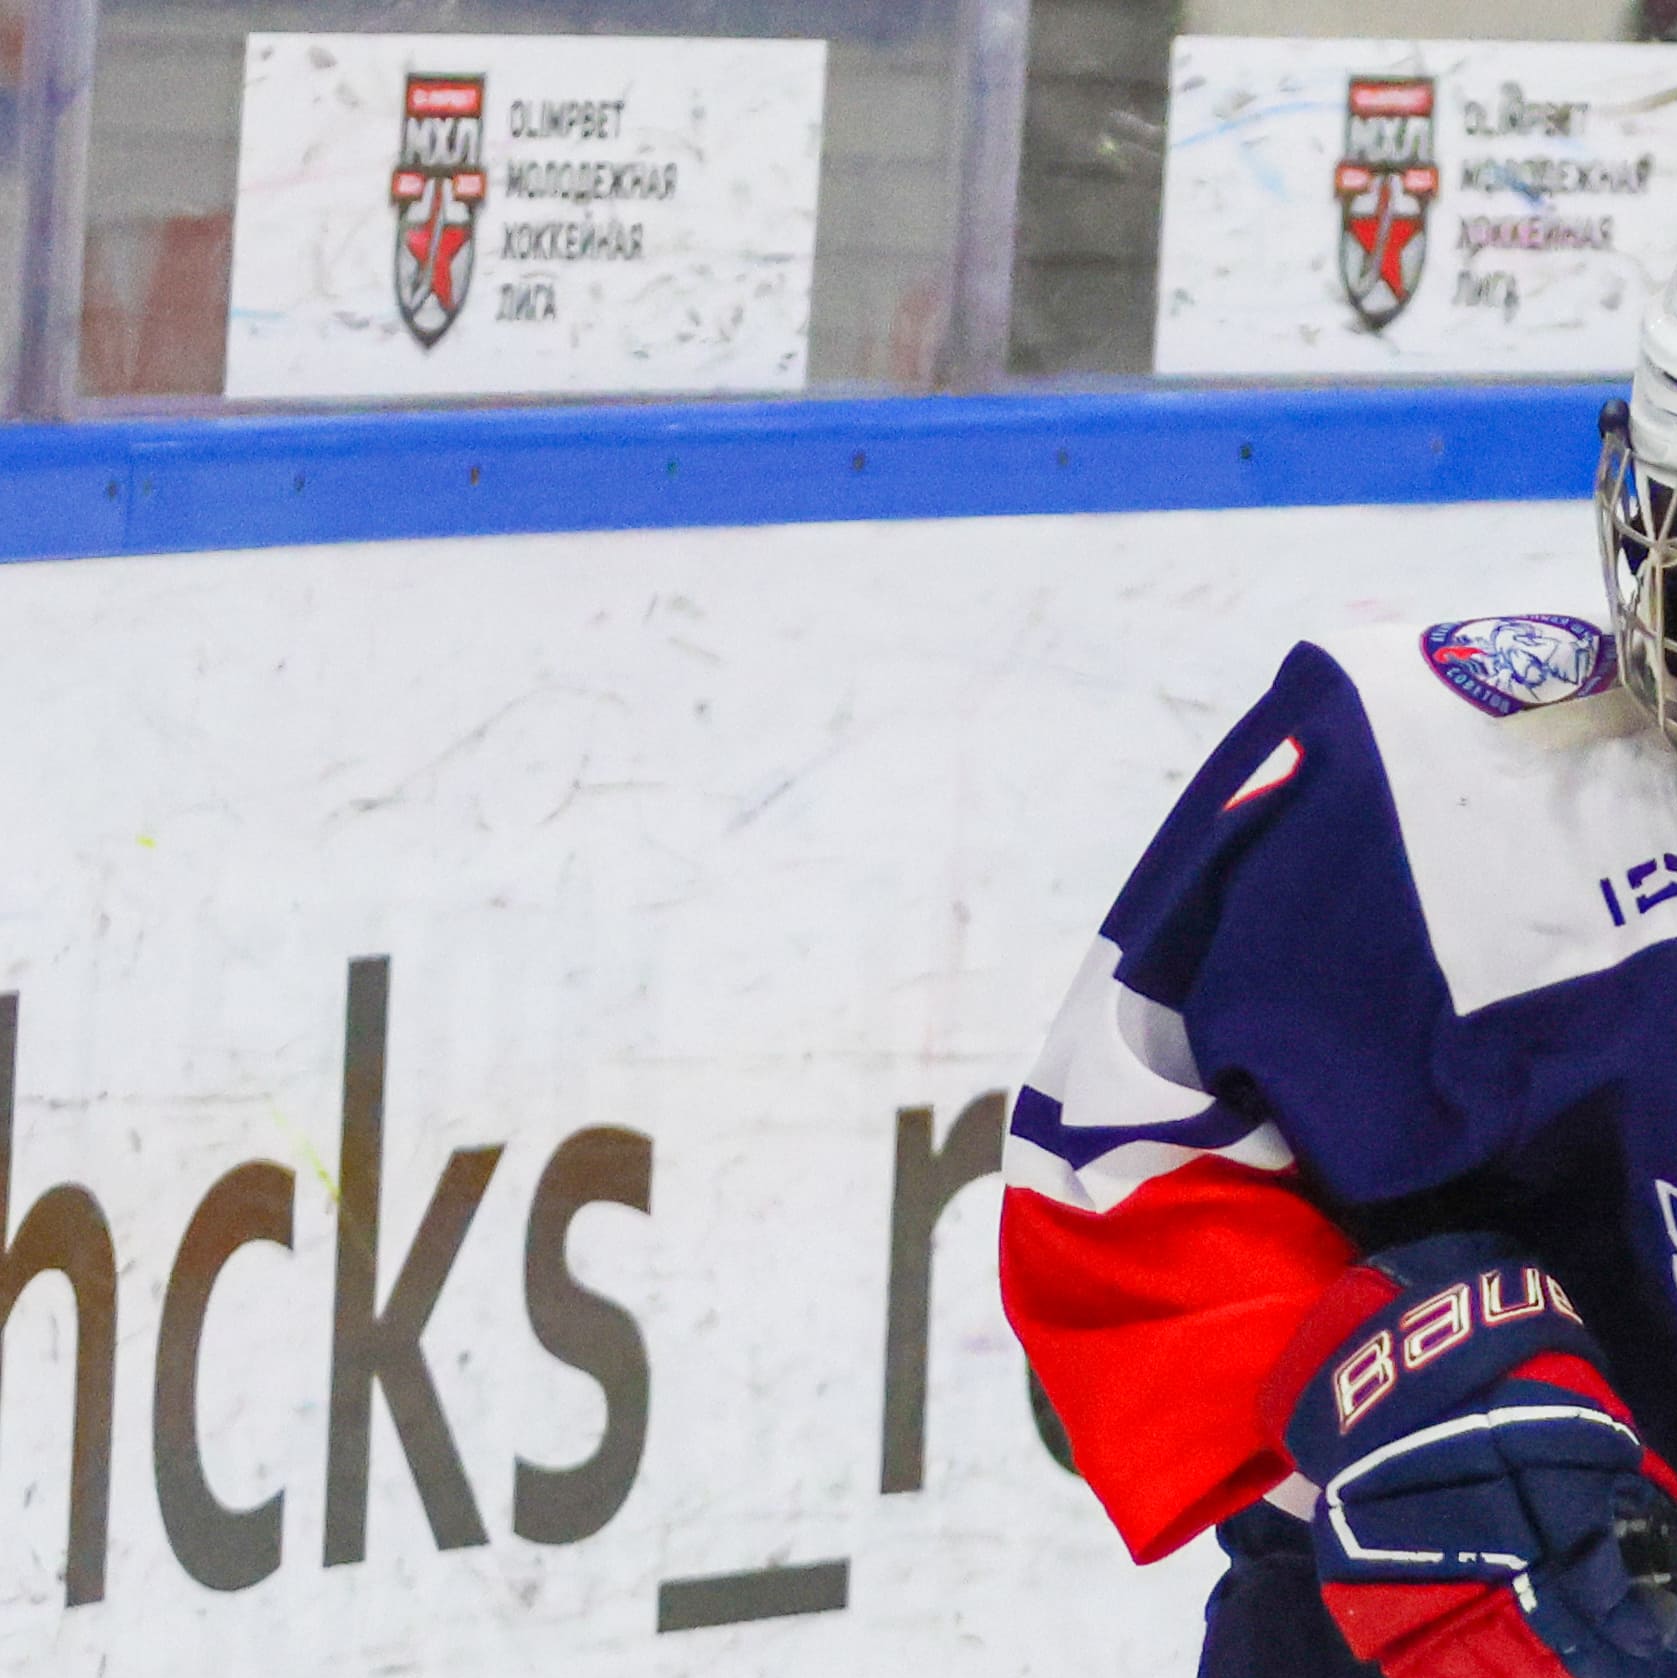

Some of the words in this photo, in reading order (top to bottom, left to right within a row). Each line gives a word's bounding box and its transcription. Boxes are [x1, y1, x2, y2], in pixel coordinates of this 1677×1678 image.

[509, 99, 624, 138] OLIMPBET
[501, 213, 644, 260] ХОККЕЙНАЯ
[496, 282, 557, 321] ЛИГА
[0, 955, 1092, 1635] hcks_r
